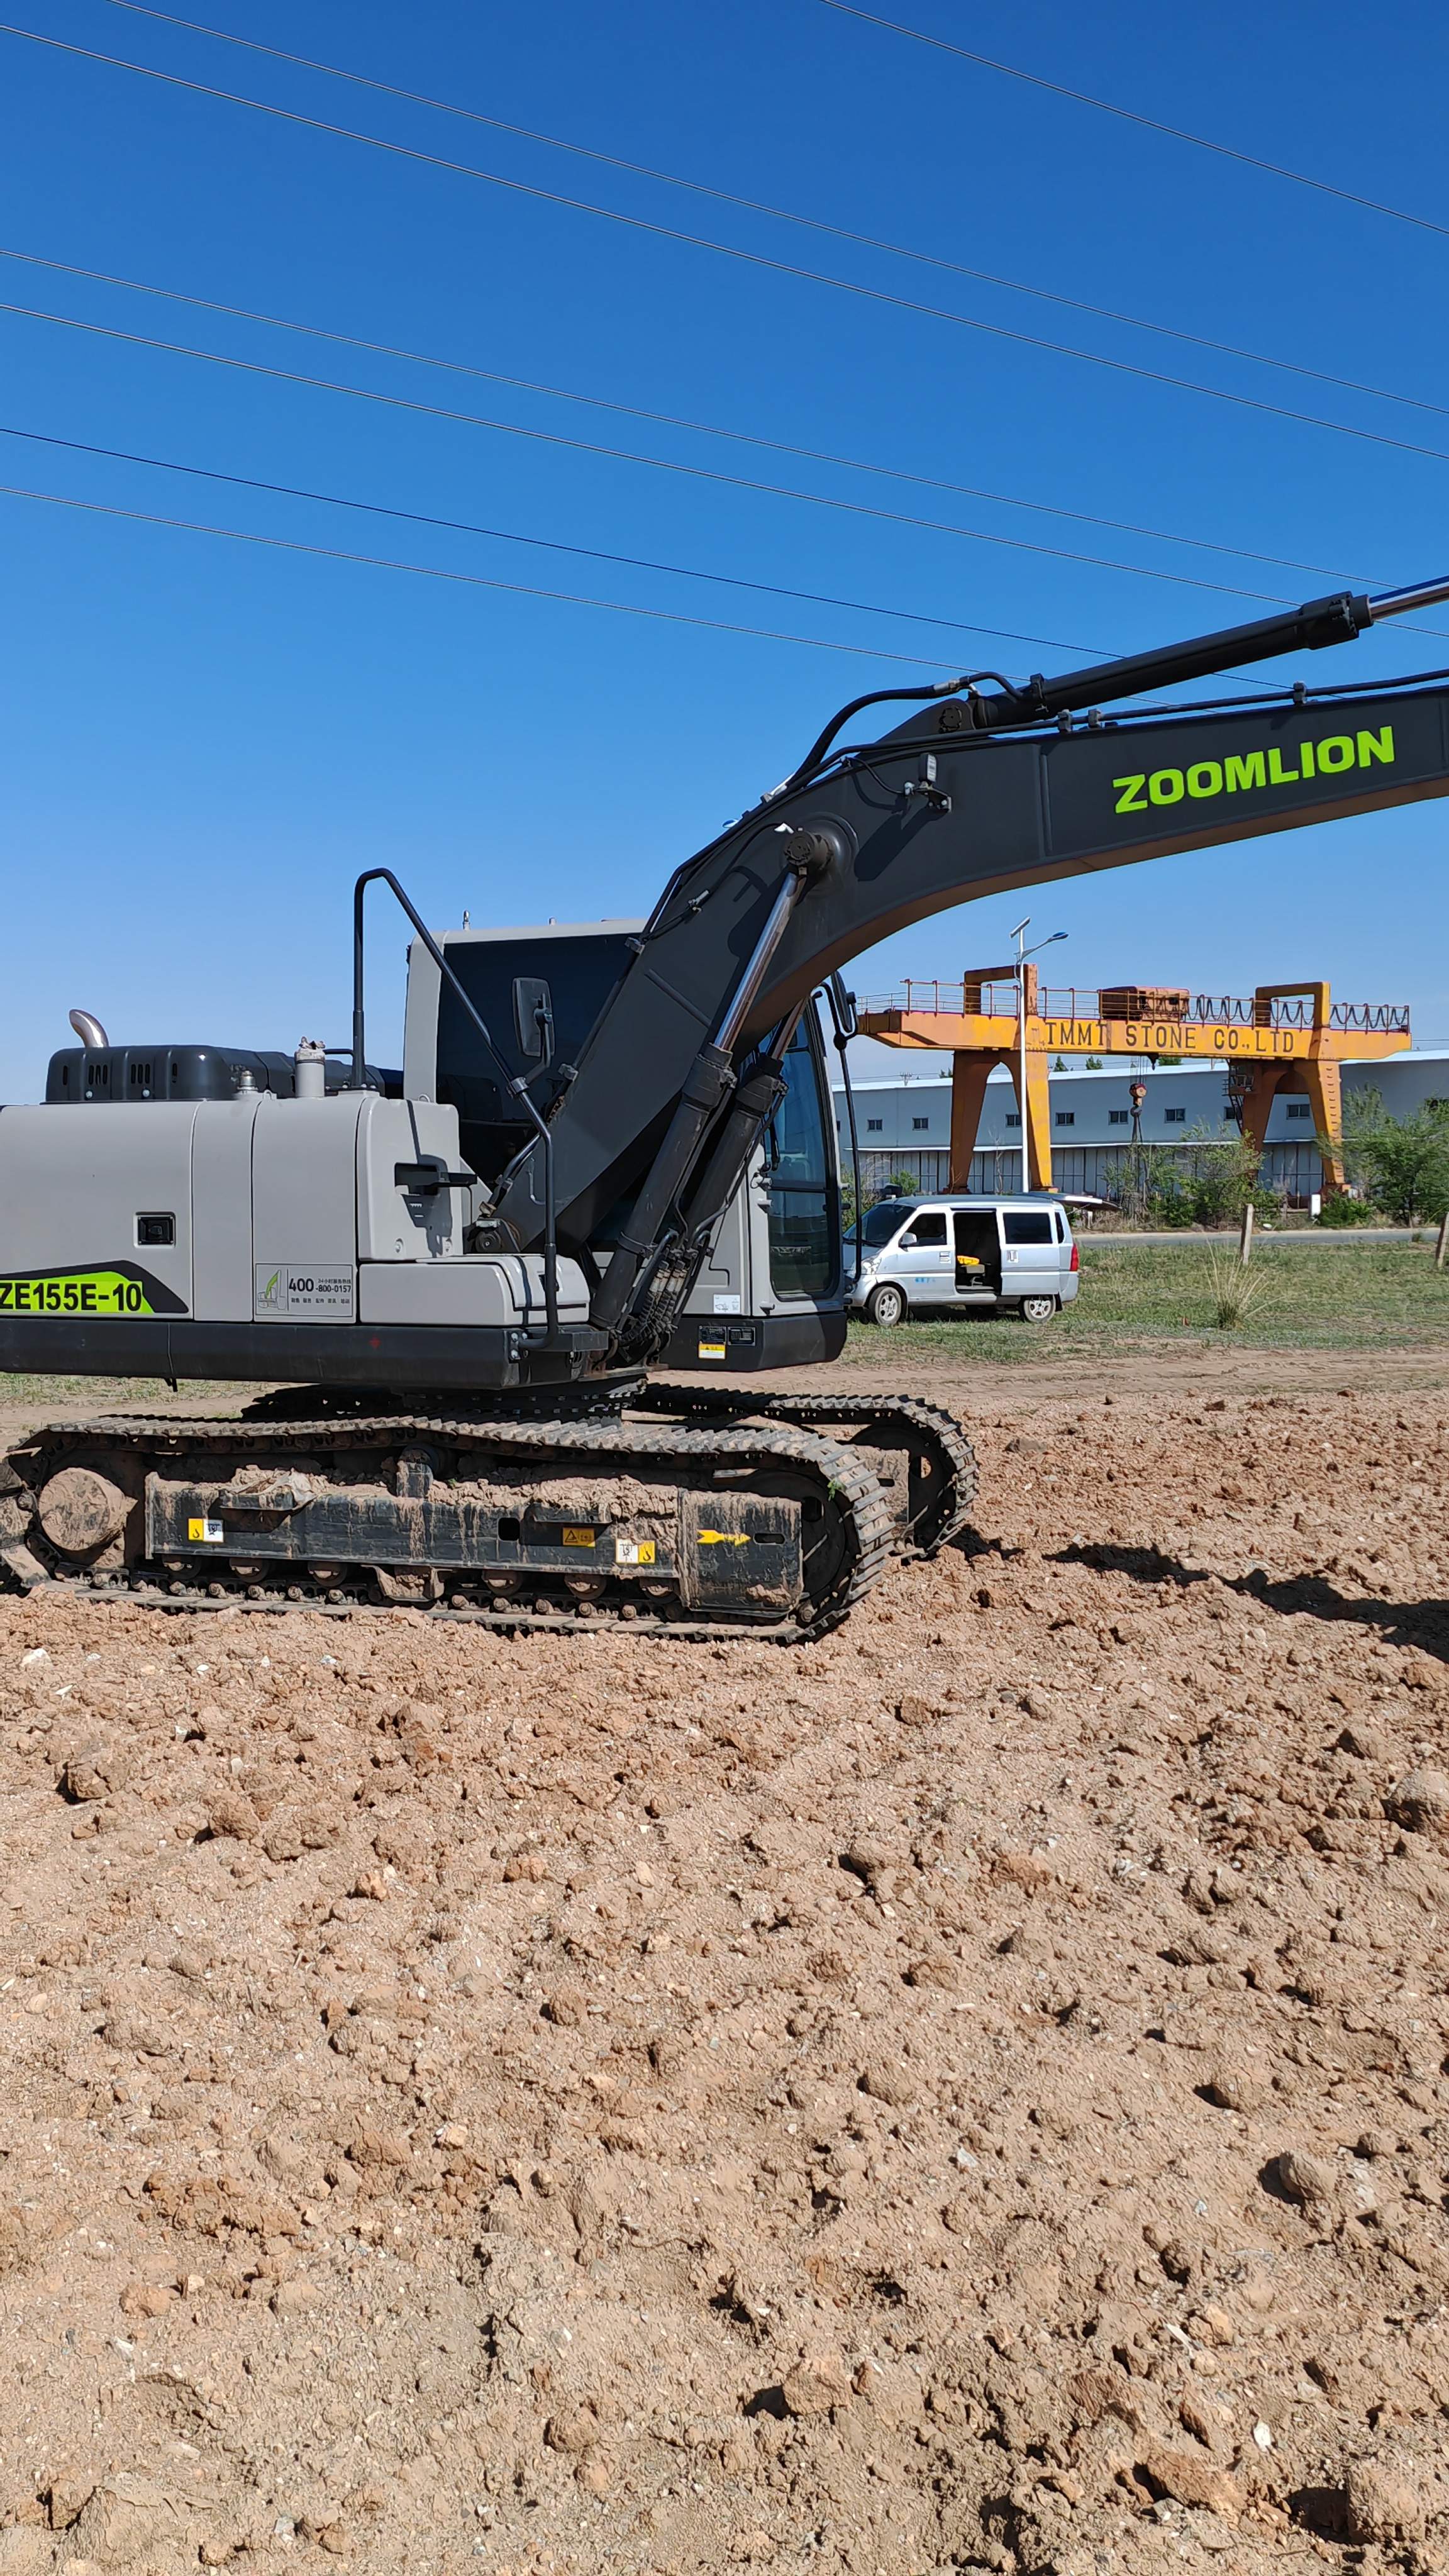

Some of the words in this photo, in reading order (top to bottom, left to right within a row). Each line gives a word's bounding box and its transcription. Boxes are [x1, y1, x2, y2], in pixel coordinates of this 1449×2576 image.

[1113, 726, 1395, 813] ZOOMLION
[1126, 1024, 1196, 1049] STONE
[0, 1282, 142, 1311] ZE155E-10
[289, 1278, 314, 1292] 400
